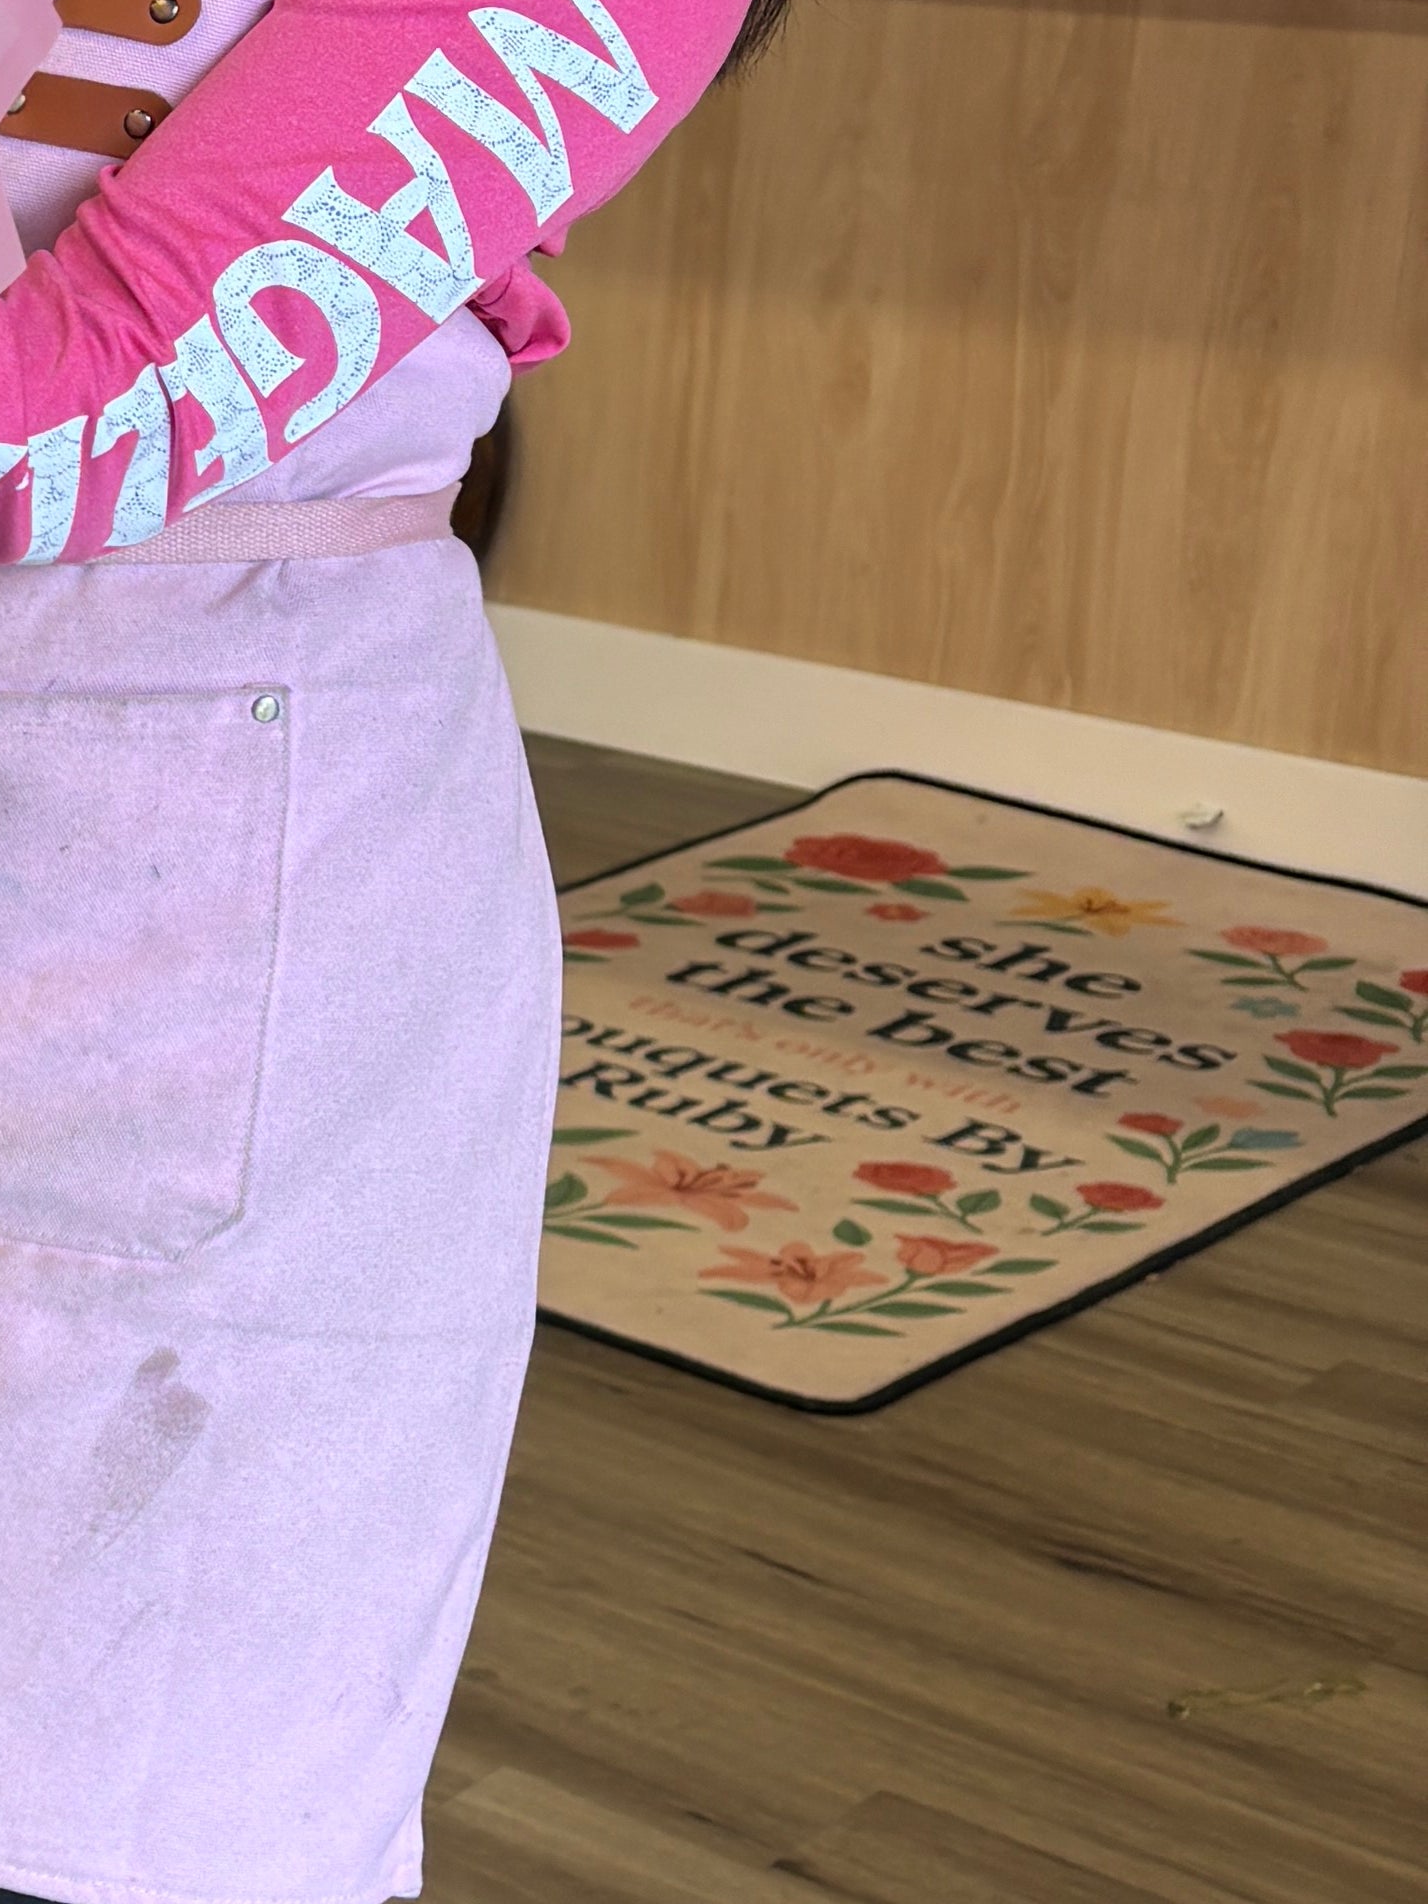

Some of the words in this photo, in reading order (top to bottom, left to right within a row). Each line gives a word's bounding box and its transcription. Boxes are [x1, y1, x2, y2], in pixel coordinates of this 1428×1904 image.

[665, 960, 855, 1023] the
[865, 1008, 1138, 1097] best
[714, 929, 1238, 1072] deserves
[919, 936, 1142, 999] she
[559, 1061, 832, 1152] Ruby
[561, 1014, 922, 1130] ouquets
[922, 1116, 1086, 1174] By
